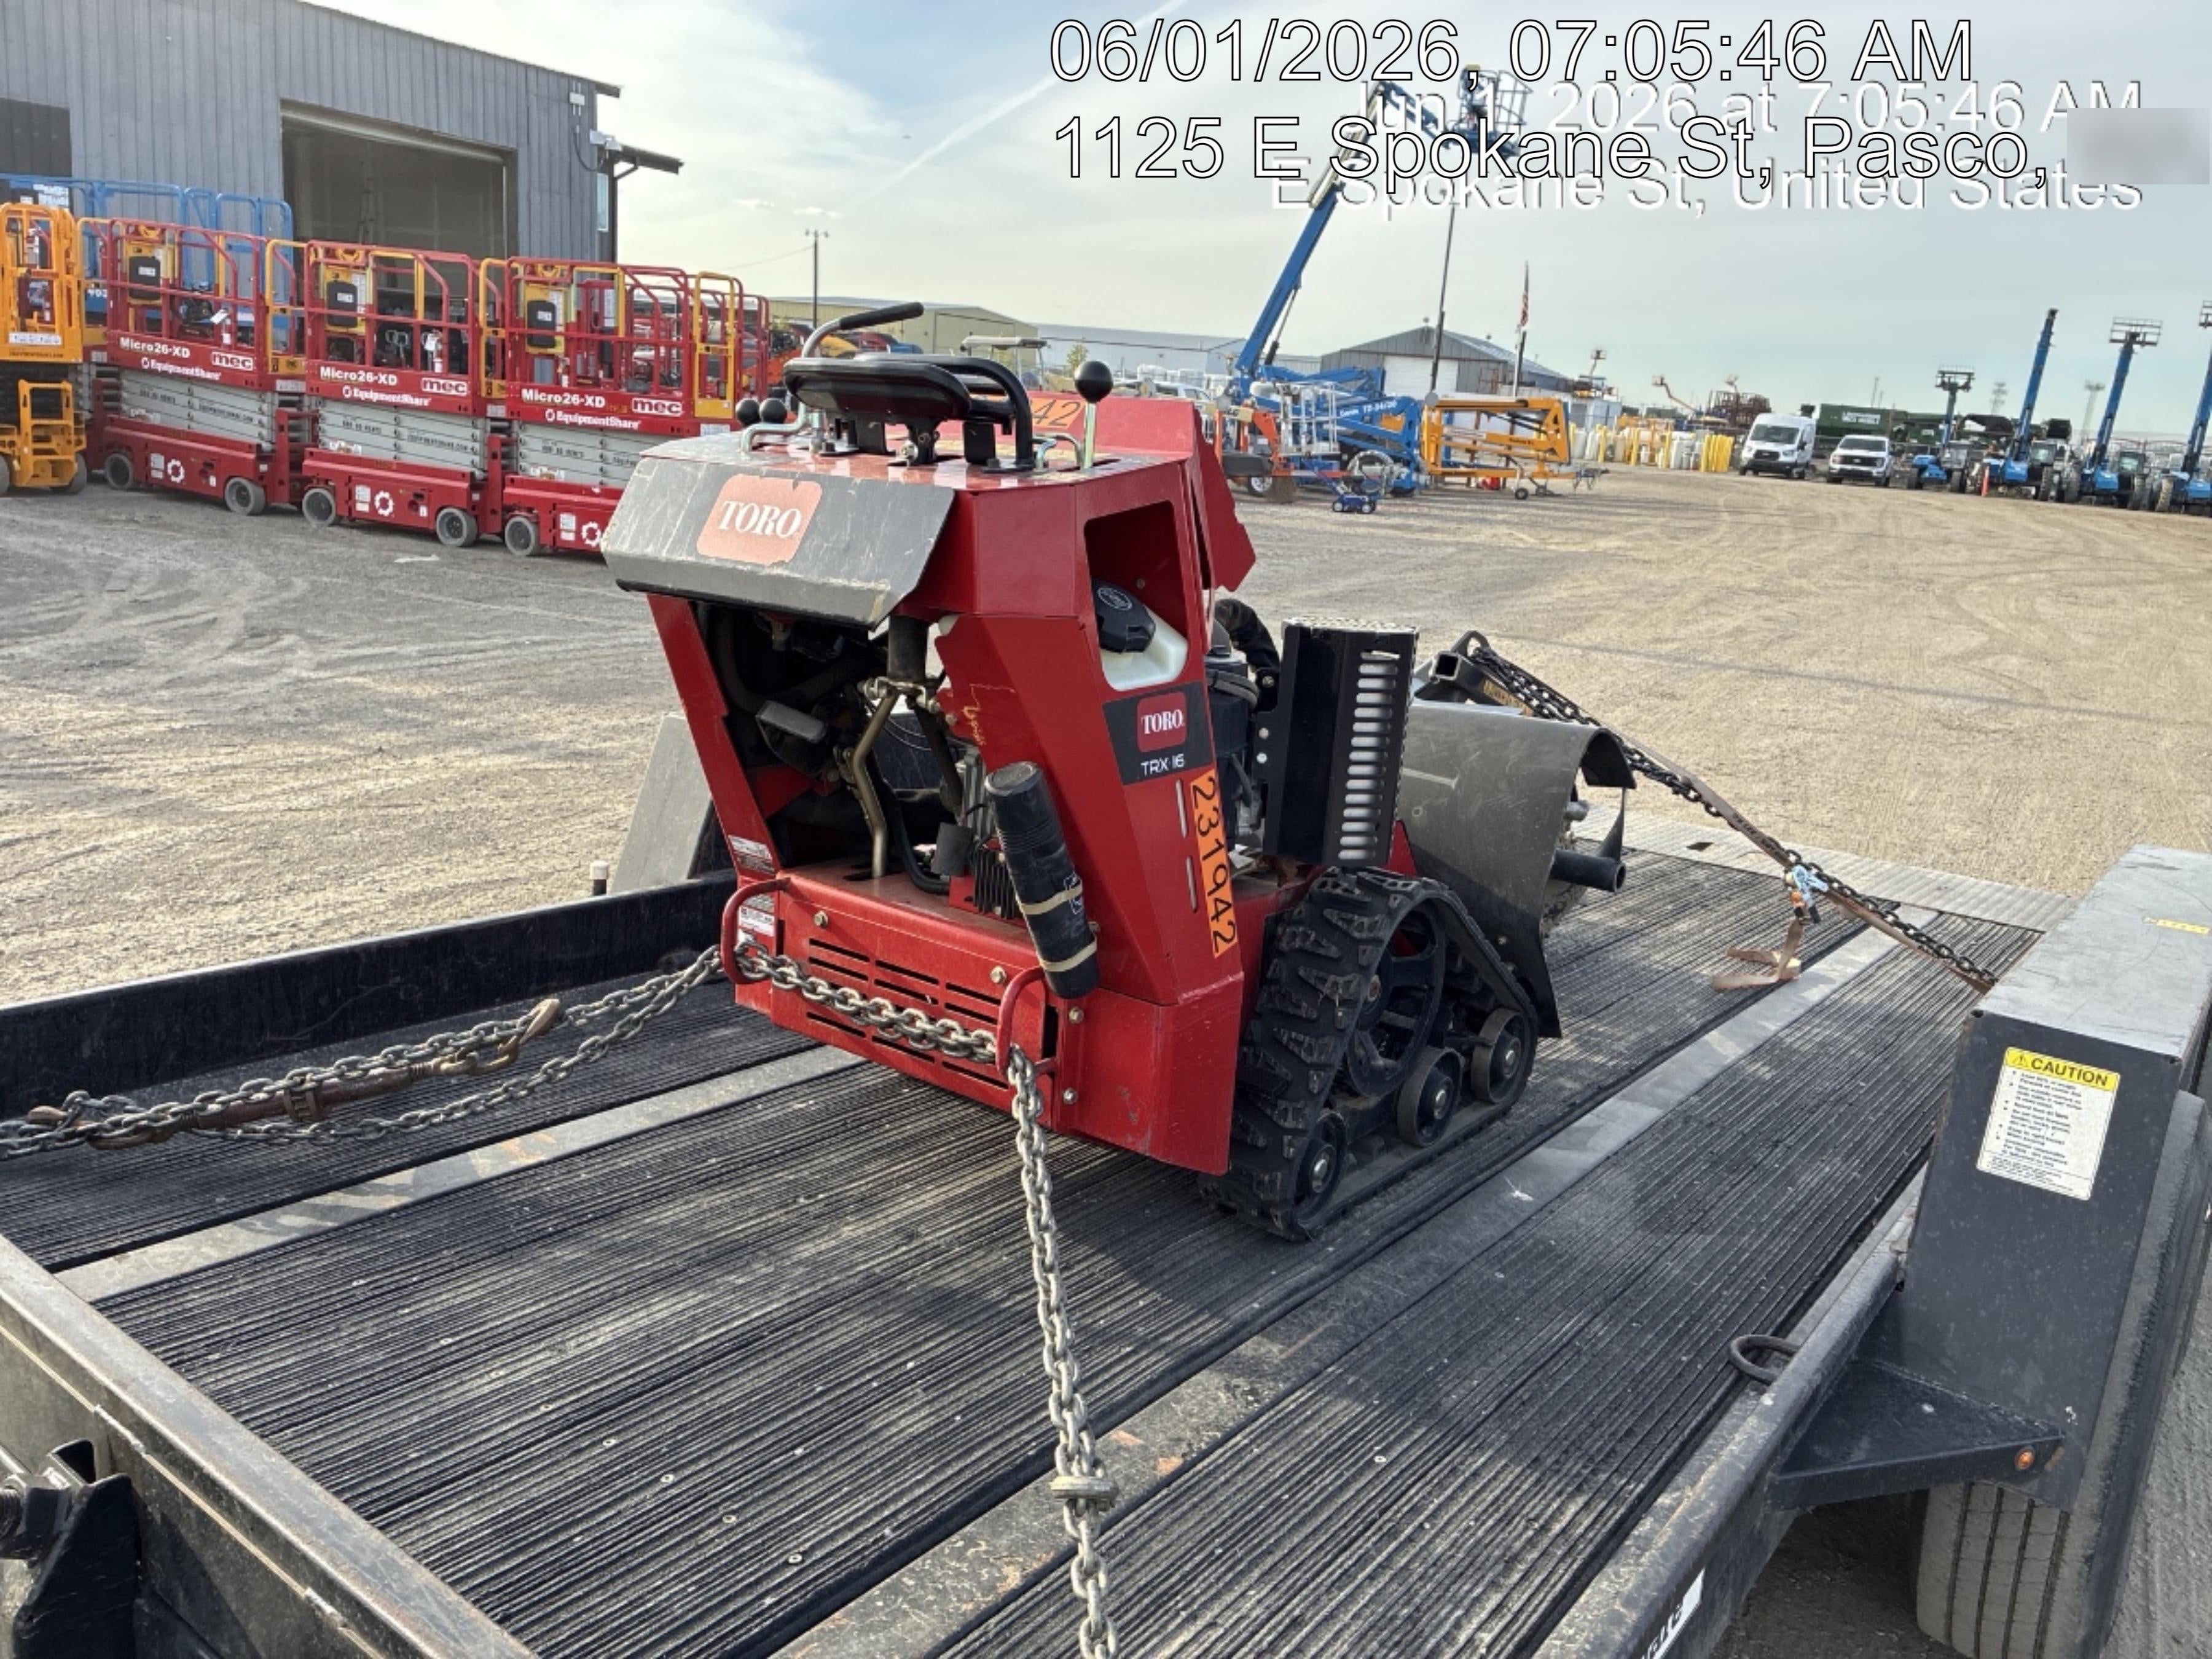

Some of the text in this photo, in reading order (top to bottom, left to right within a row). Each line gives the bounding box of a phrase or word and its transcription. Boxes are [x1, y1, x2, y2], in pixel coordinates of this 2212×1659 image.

[119, 337, 190, 358] Micro26-XD
[213, 353, 253, 370] mec
[320, 366, 398, 386] Micro26-XD
[422, 378, 467, 395] mec
[521, 388, 605, 408] Micro26-XD
[633, 399, 681, 415] mec
[556, 410, 640, 429] EquipmentShare
[718, 500, 802, 538] TORO
[1141, 709, 1185, 734] TORO
[1193, 776, 1237, 953] 231942
[2031, 1057, 2108, 1086] CAUTION
